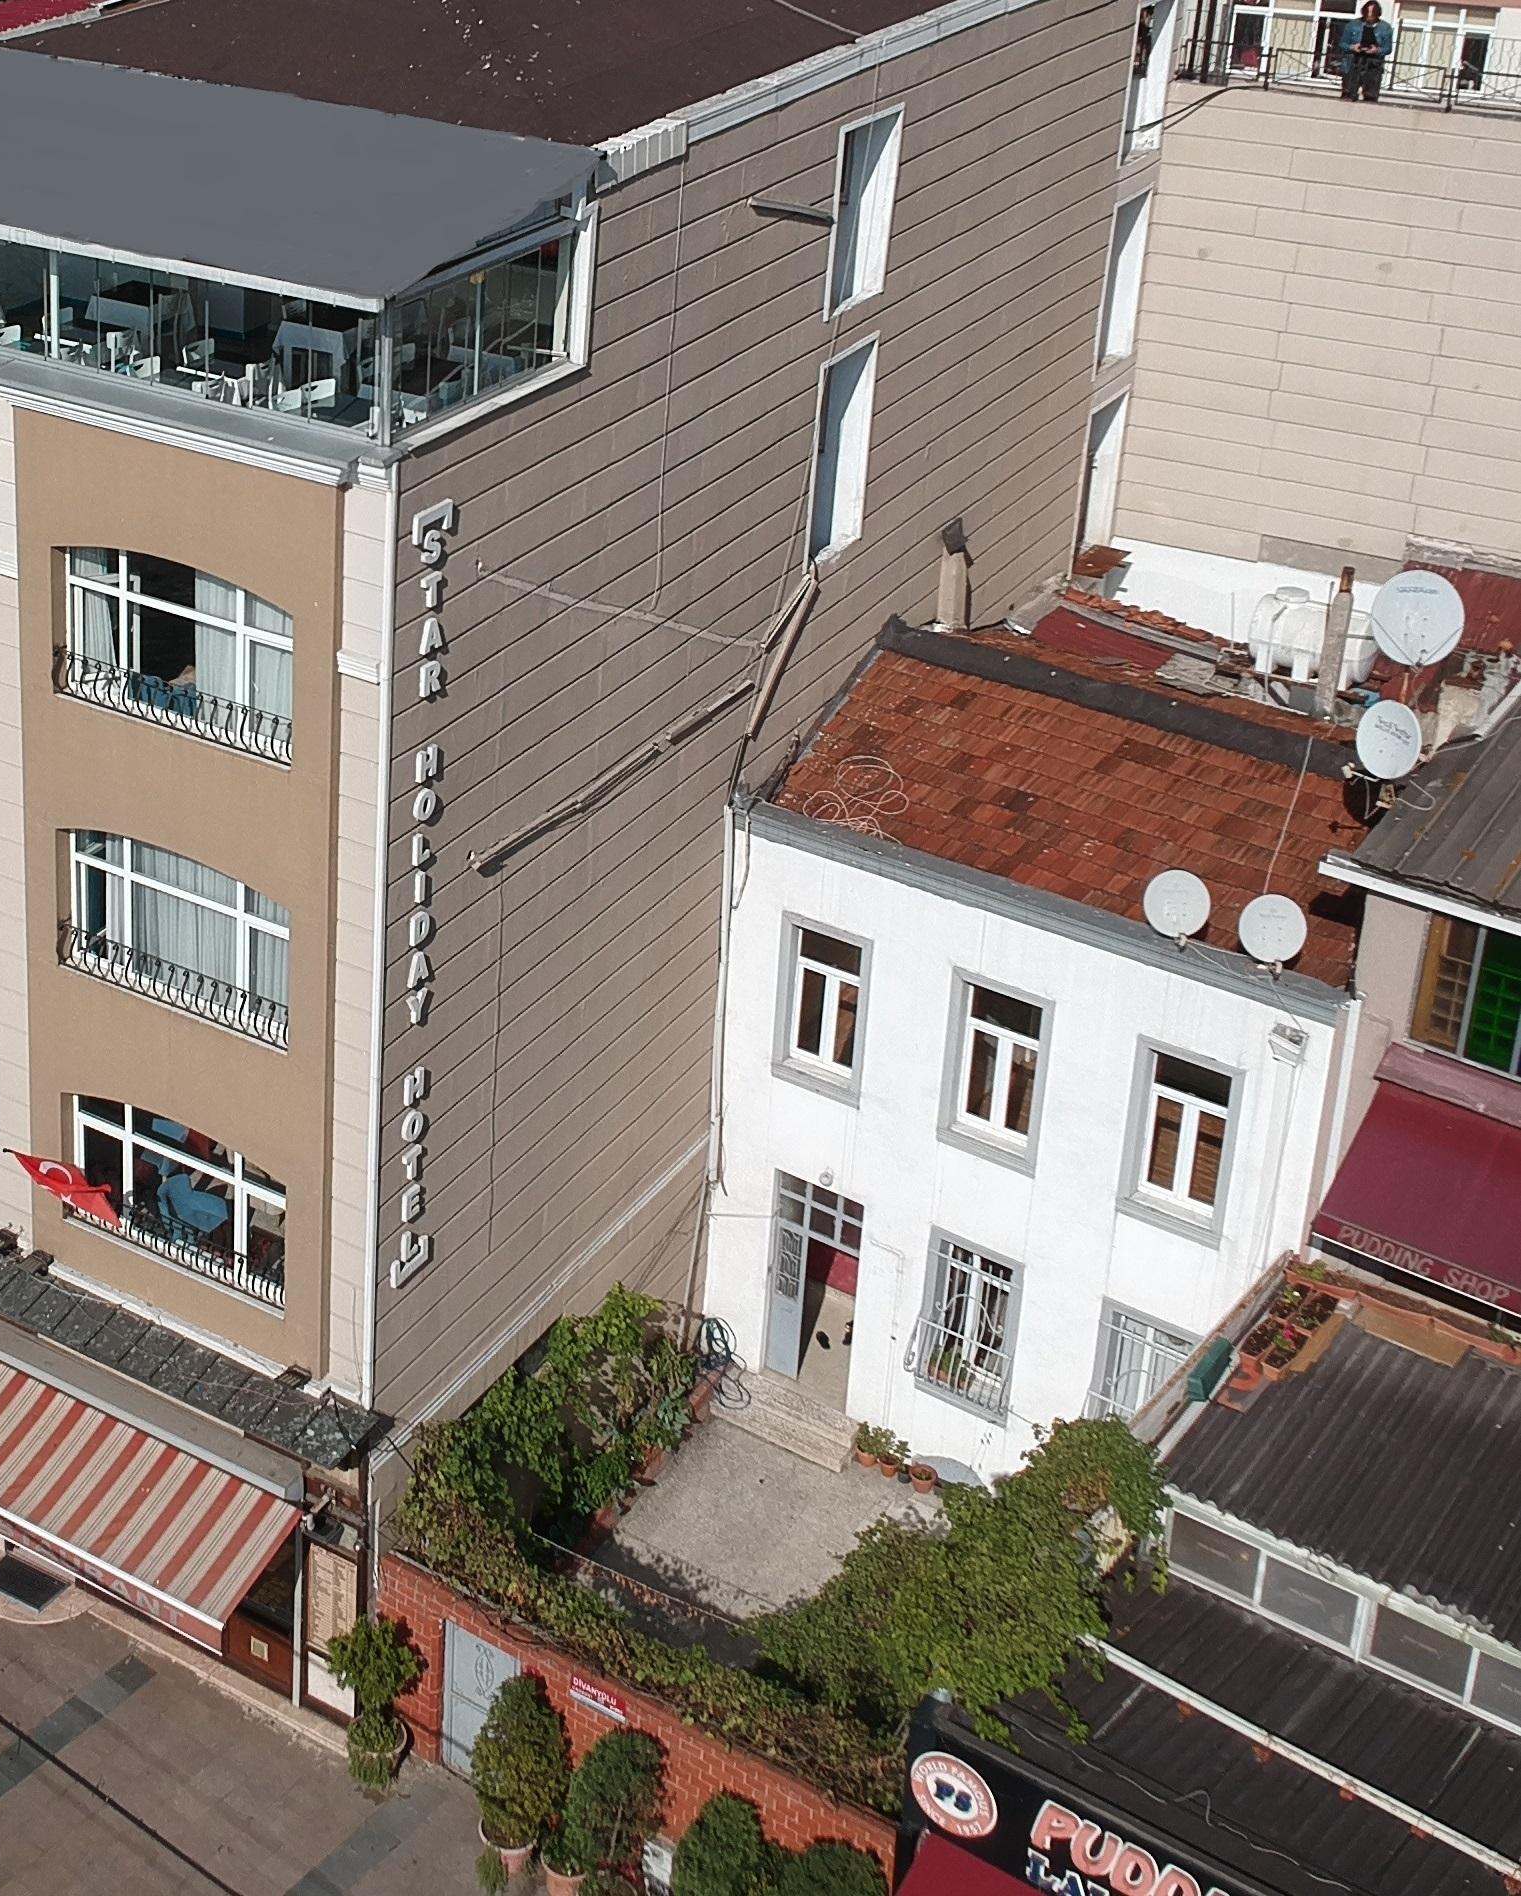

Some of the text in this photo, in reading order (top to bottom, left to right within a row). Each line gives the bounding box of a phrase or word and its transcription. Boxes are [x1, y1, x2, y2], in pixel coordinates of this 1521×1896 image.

[399, 530, 444, 1263] STAR HOLIDAY HOTEL
[1336, 1225, 1510, 1304] PUDDING SHOP
[1030, 1799, 1231, 1896] PUDD
